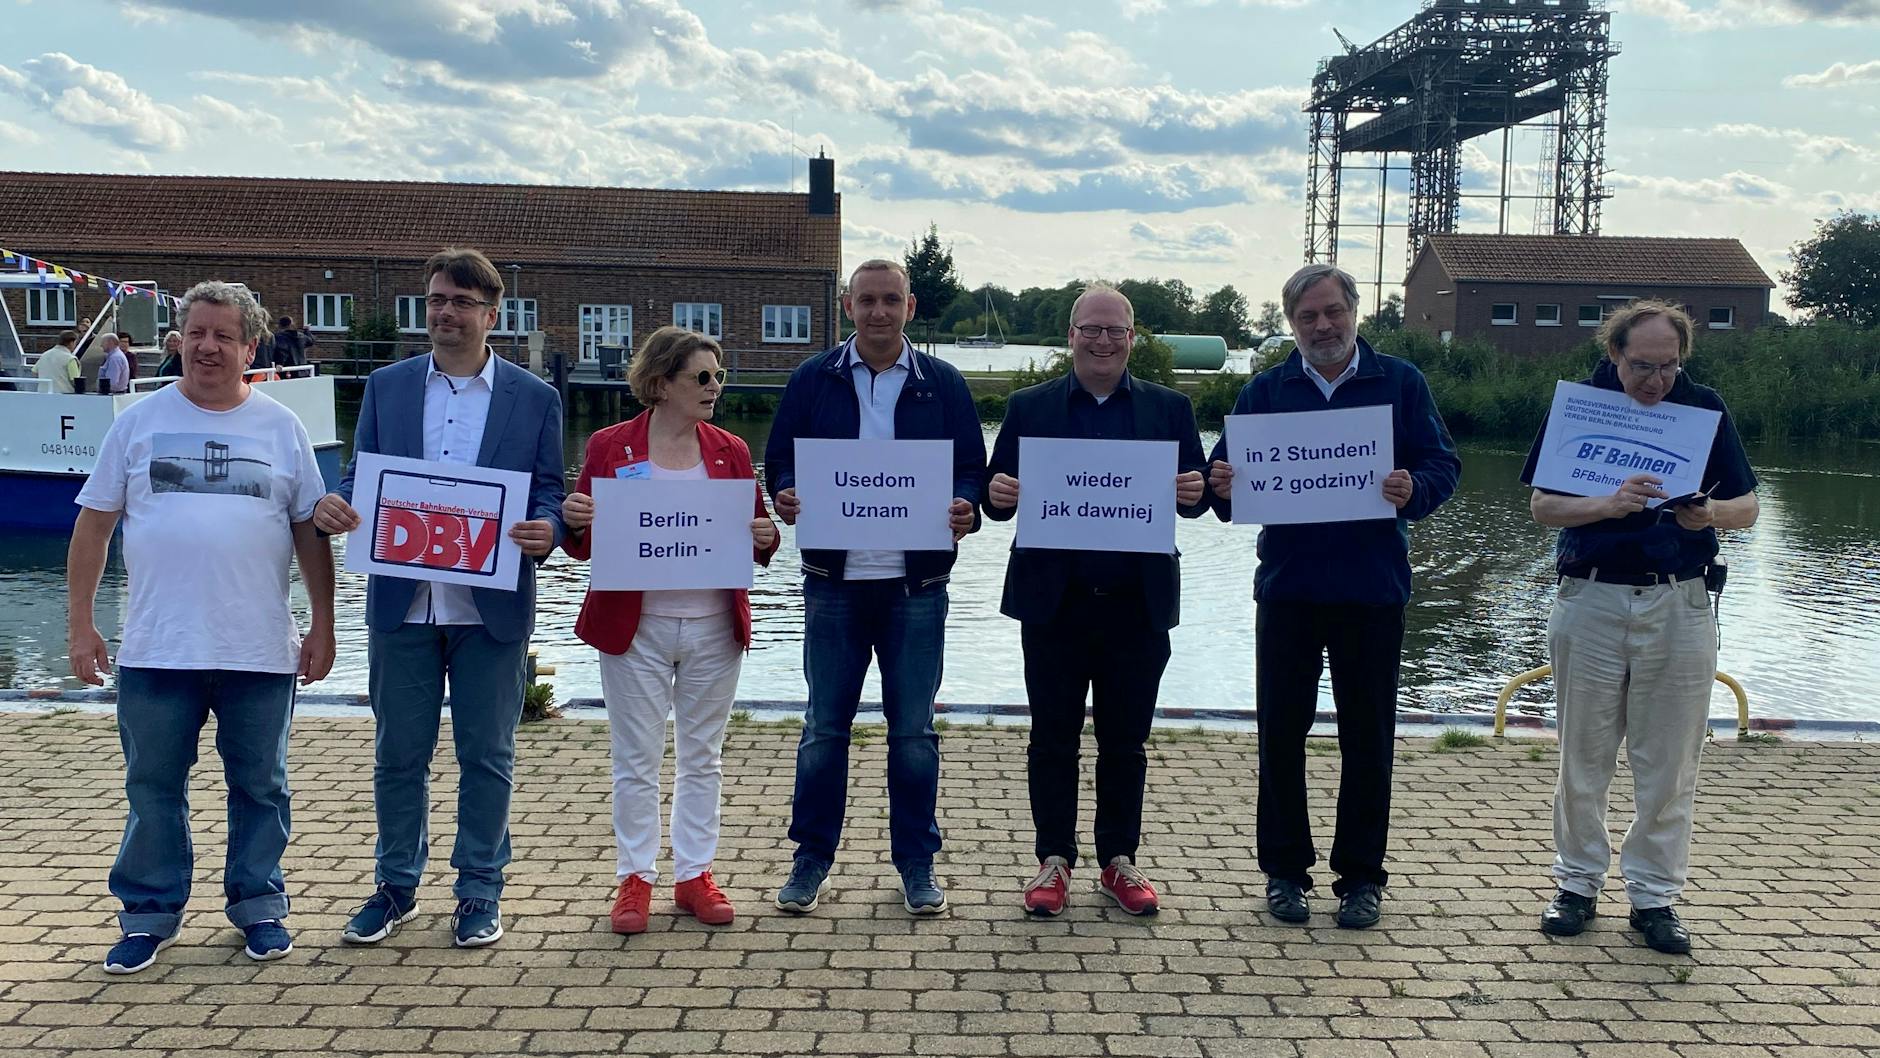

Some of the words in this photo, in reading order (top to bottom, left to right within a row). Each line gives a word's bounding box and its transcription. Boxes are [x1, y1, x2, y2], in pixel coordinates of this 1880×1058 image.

[1564, 412, 1587, 422] VEREIN
[1565, 404, 1601, 417] DEUTSCHER
[1601, 410, 1628, 421] BAHNEN
[60, 415, 75, 440] F
[41, 443, 95, 457] 04814040
[1246, 448, 1263, 463] in
[1269, 447, 1281, 462] 2
[1287, 440, 1377, 461] Stunden!
[1576, 442, 1606, 461] BF
[1604, 447, 1677, 475] Bahnen
[834, 471, 916, 488] Usedom
[1065, 471, 1132, 488] wieder
[1250, 479, 1266, 492] w
[1272, 476, 1284, 491] 2
[1289, 470, 1375, 494] godziny!
[381, 497, 419, 509] Deutscher
[419, 502, 499, 519] Bahnkunden-Verband
[841, 501, 908, 518] Uznam
[1041, 500, 1071, 520] jak
[1076, 500, 1153, 524] dawniej
[639, 511, 698, 528] Berlin
[376, 507, 498, 571] DBV
[638, 541, 698, 558] Berlin
